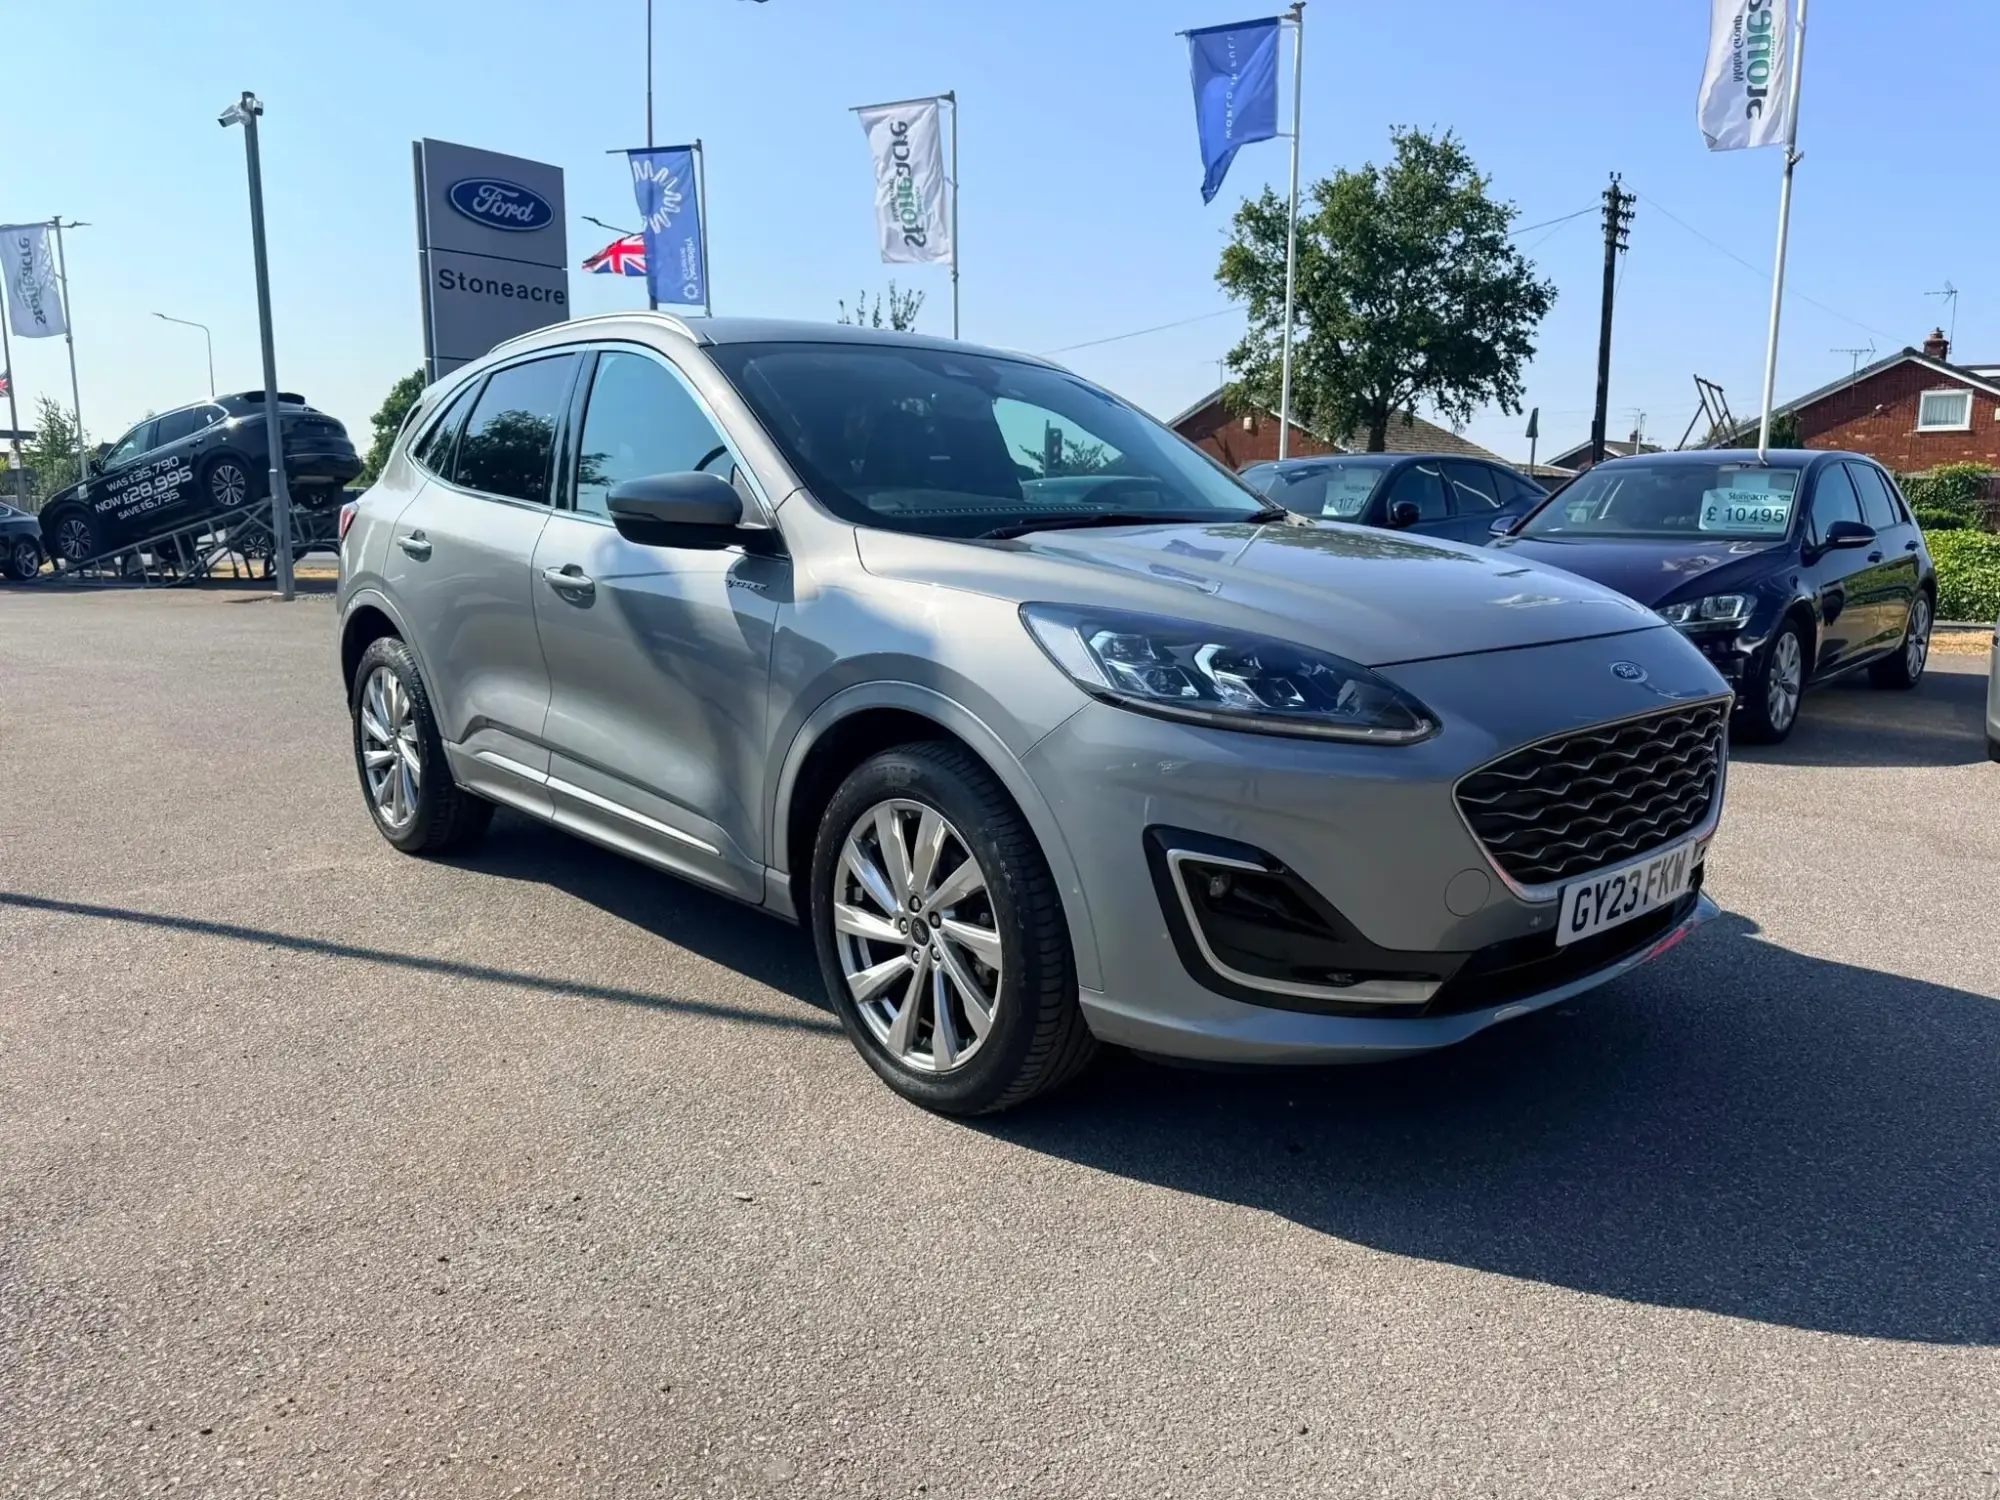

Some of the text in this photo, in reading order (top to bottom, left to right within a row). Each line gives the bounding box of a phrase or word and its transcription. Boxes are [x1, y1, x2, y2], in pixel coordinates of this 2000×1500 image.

[472, 185, 535, 222] Ford
[438, 268, 566, 305] Stoneacre
[95, 465, 194, 513] NOW £28,995
[106, 477, 129, 492] WAS
[117, 504, 141, 520] SAVE
[1706, 506, 1785, 523] £ 10495
[1571, 850, 1687, 933] GY23 FKW
